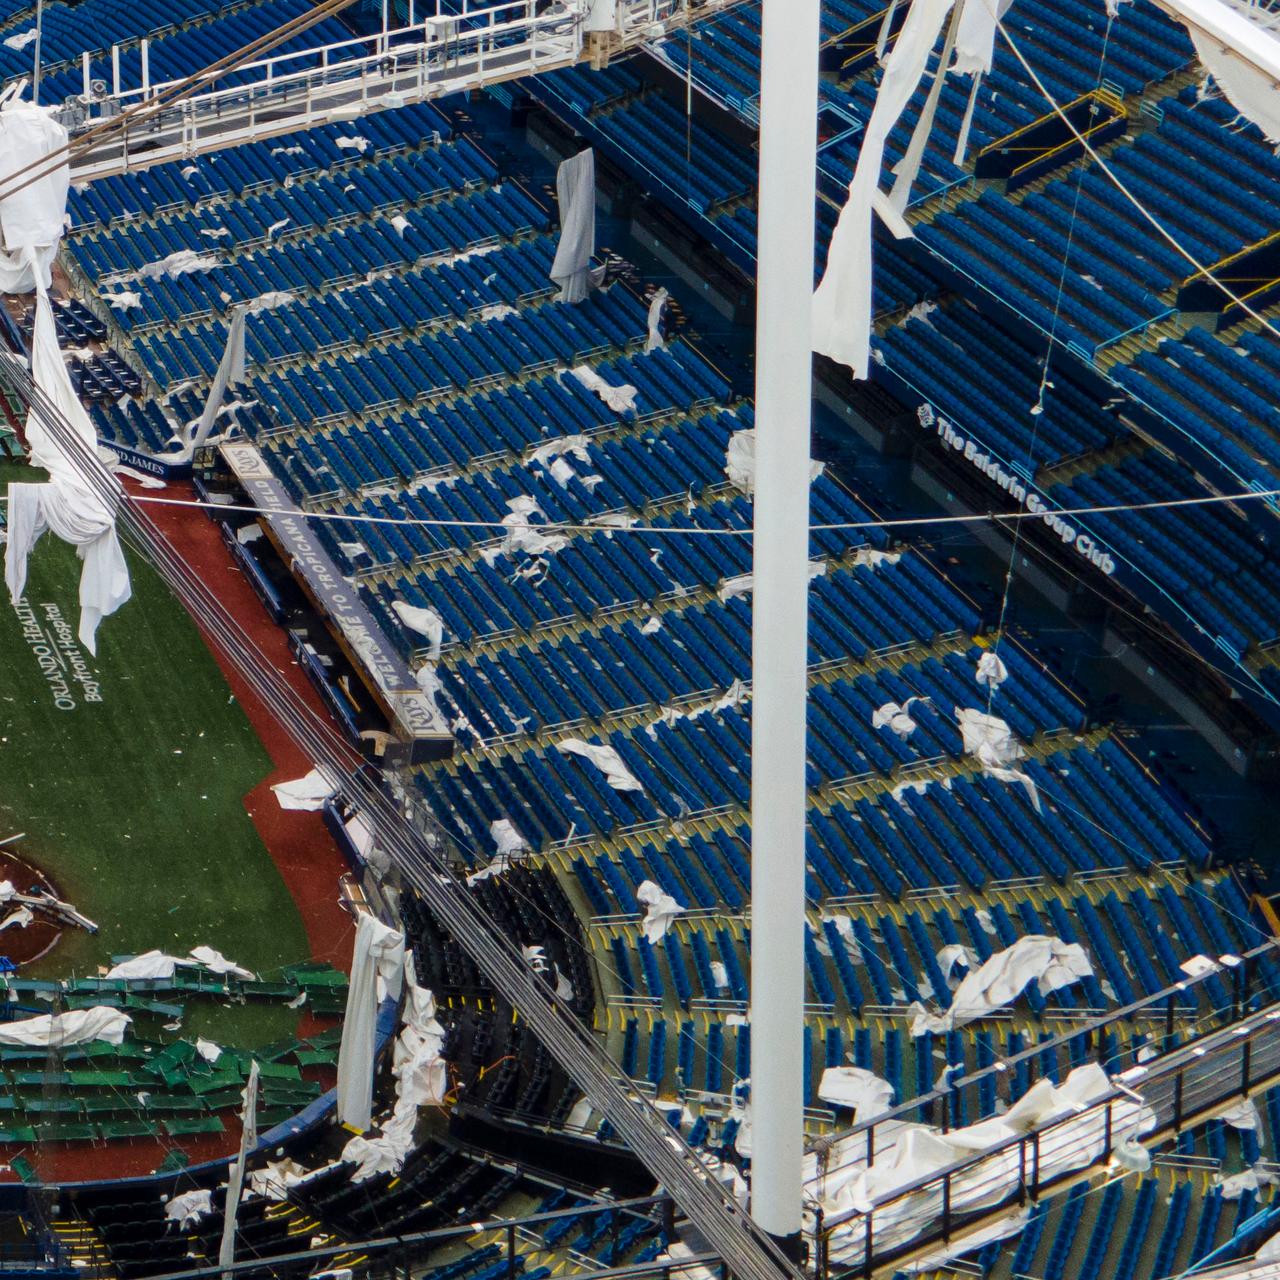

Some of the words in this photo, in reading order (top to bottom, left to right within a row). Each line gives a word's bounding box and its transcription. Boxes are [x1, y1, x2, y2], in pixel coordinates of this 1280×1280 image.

[129, 455, 165, 475] JAMES
[936, 417, 965, 451] The
[963, 440, 1027, 502] Baldwin
[1026, 493, 1076, 544] Group
[1075, 534, 1116, 576] Club
[40, 603, 77, 649] Hospital
[331, 594, 353, 613] TO
[32, 645, 76, 711] ORLANDO
[64, 648, 103, 703] Bayfront
